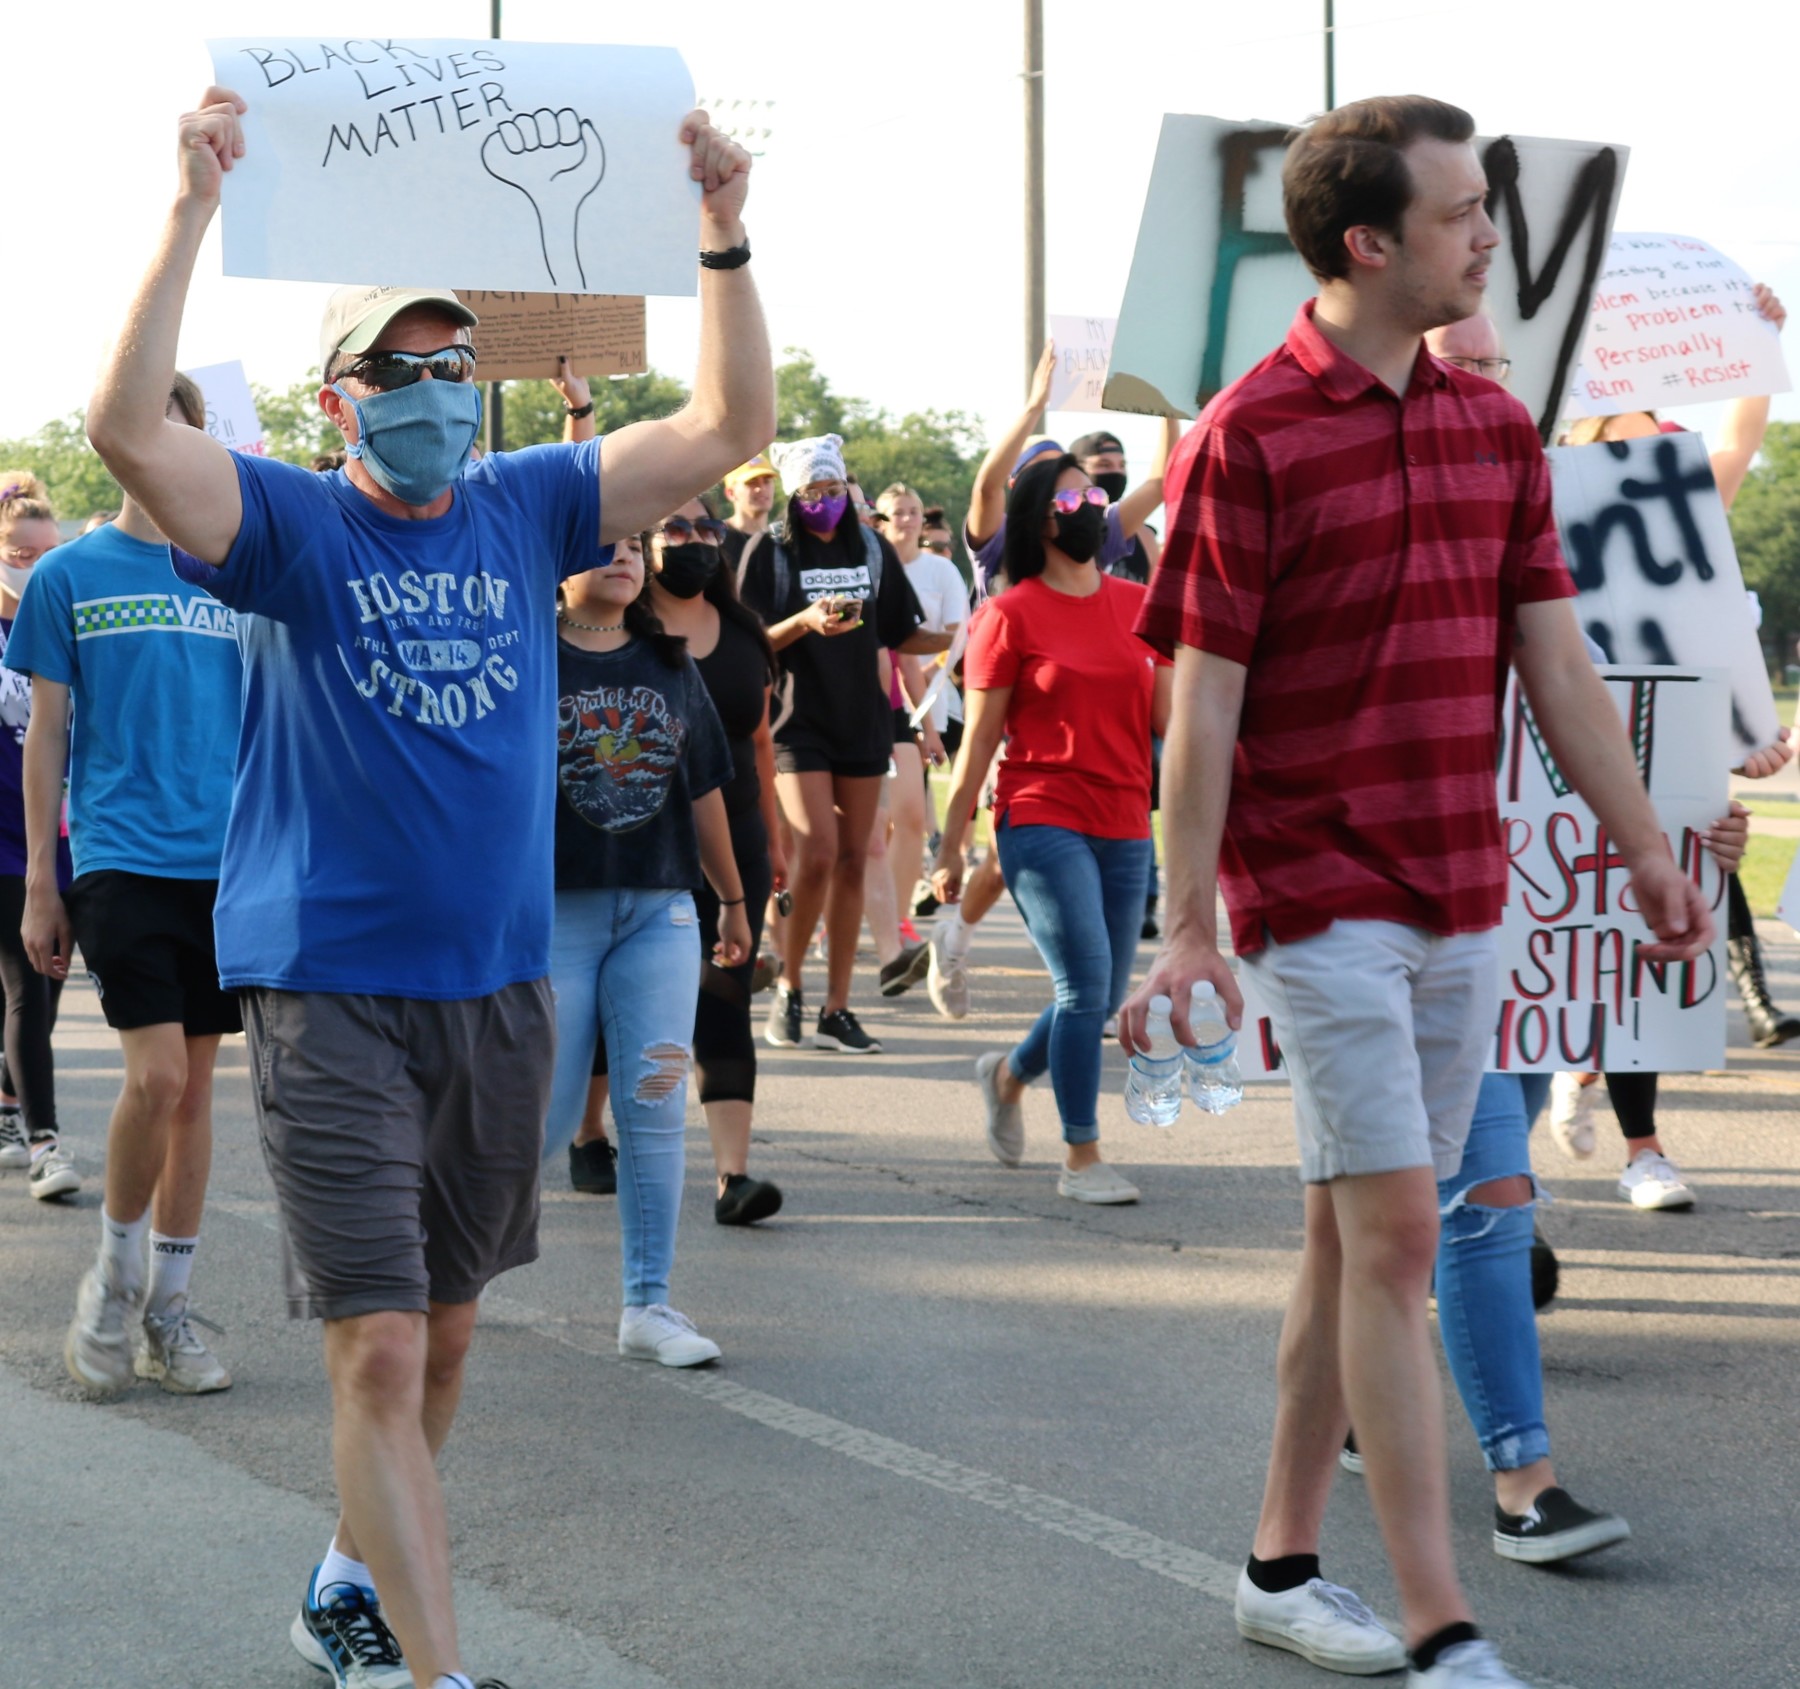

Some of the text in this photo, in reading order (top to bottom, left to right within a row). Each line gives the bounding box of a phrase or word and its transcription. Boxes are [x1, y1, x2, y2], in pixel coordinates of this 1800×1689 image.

[239, 39, 428, 87] BLACK
[355, 50, 506, 99] LIVES
[323, 82, 513, 167] MATTER
[1648, 281, 1716, 299] because
[1662, 360, 1751, 388] #Resist
[488, 630, 520, 650] DEPT
[357, 653, 519, 728] STRONG
[1511, 924, 1718, 1026] STAND
